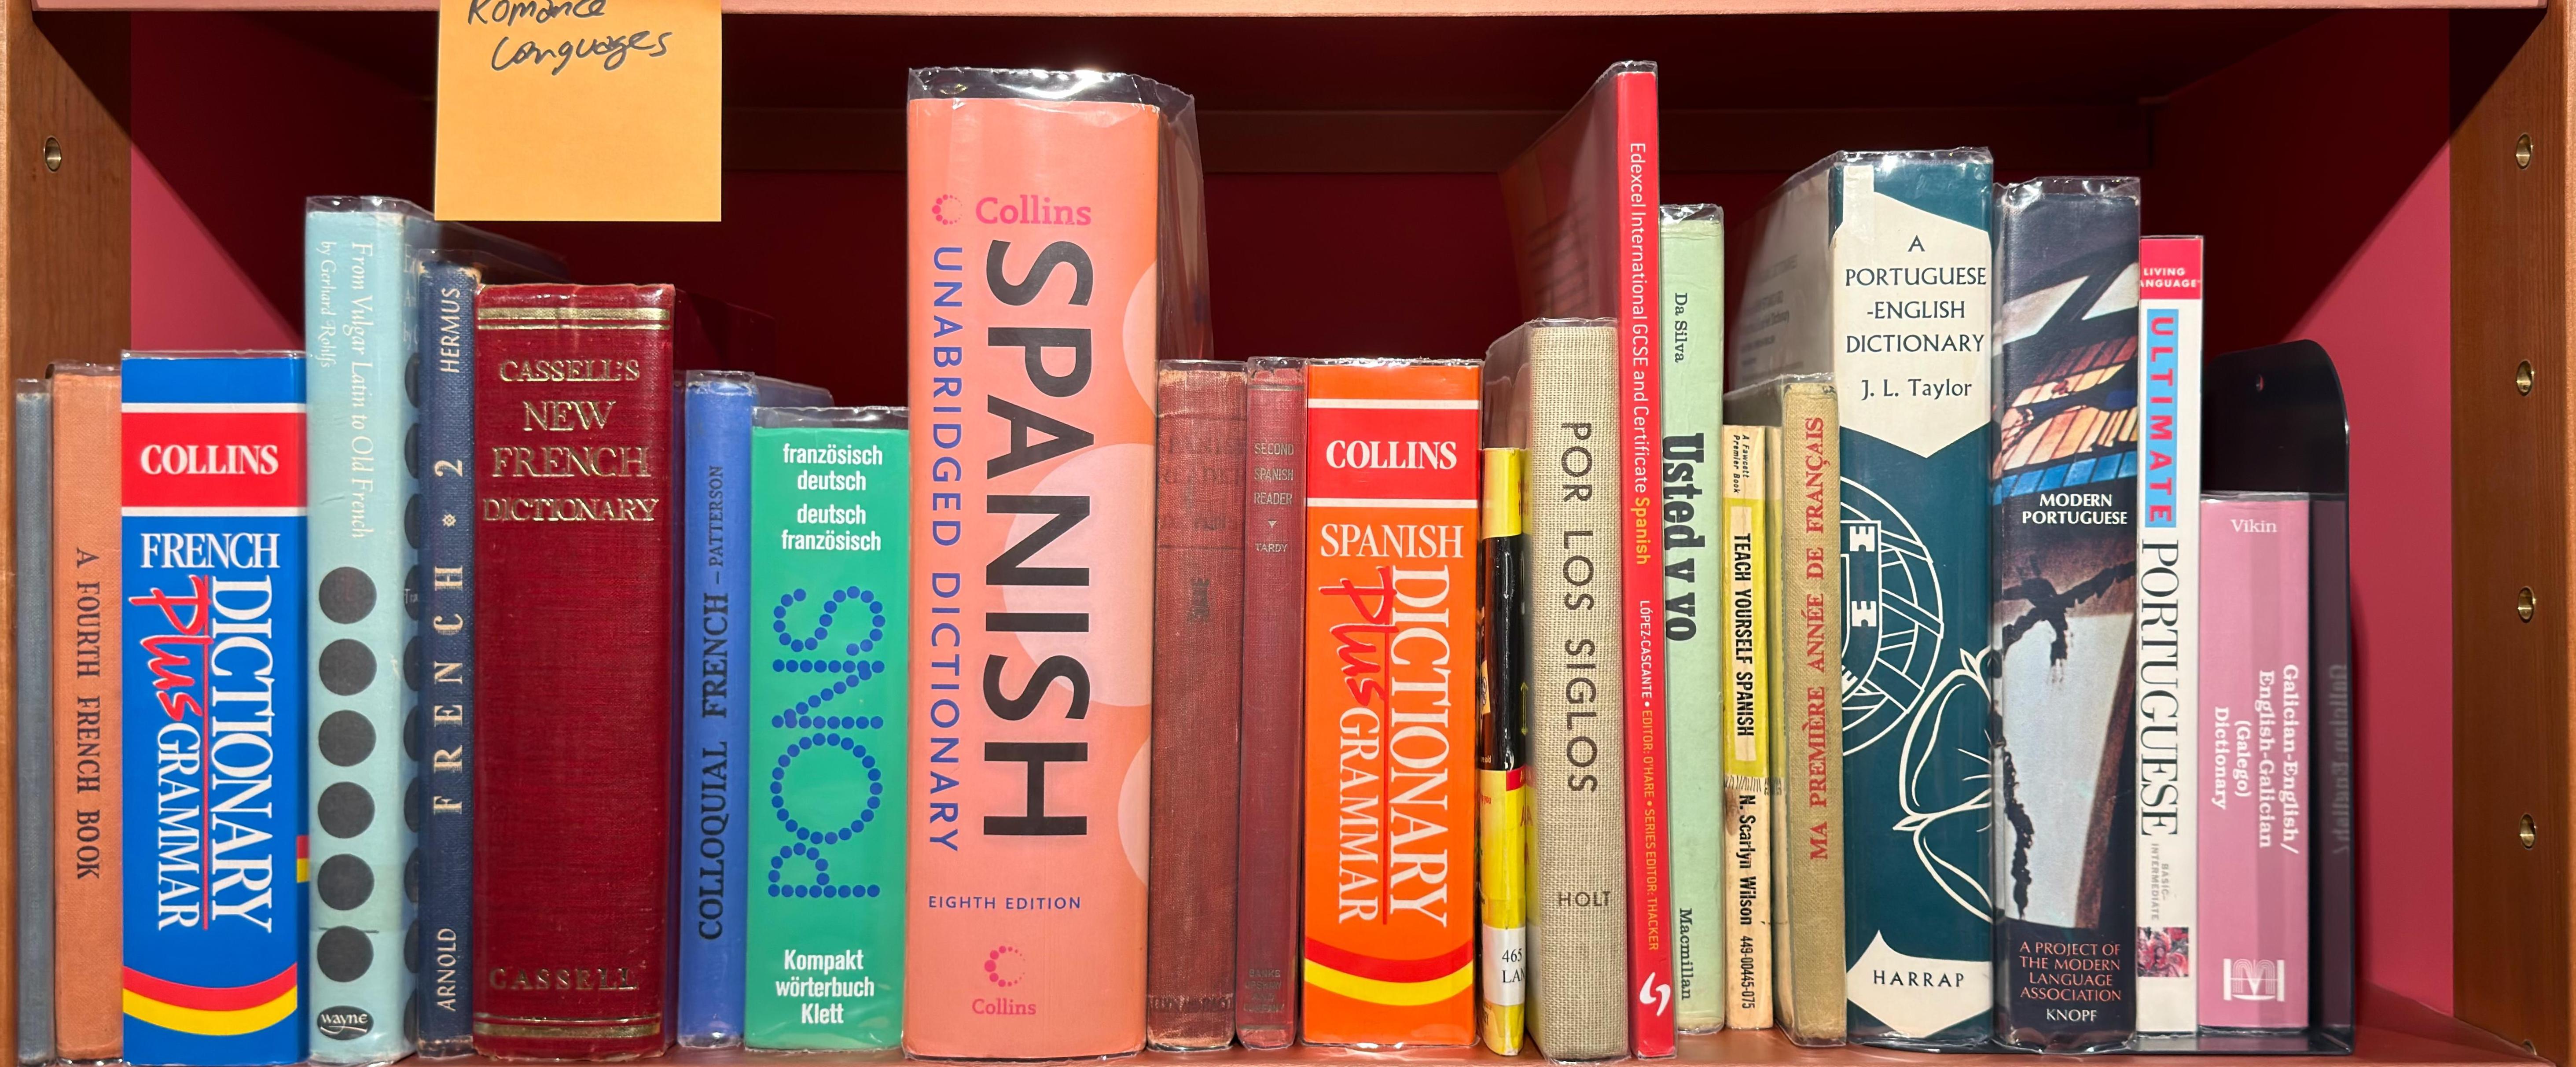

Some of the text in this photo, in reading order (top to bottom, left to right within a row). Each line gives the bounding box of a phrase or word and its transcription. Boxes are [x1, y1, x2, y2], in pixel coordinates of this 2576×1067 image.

[976, 195, 1091, 226] Collins
[1908, 235, 1925, 252] A
[1845, 267, 1986, 286] PORTUGUESE
[2140, 279, 2196, 287] ANGUAGE
[2143, 268, 2185, 276] LIVING
[316, 242, 337, 368] by Gerhard Rohlfs
[1867, 301, 1965, 319] -ENGLISH
[1675, 293, 1688, 363] Da Silva
[1630, 143, 1651, 564] Edexcel International GCSE and Certificate Spanish
[1847, 334, 1984, 353] DICTIONARY
[500, 359, 640, 382] CASSELL'S
[342, 243, 374, 538] From Vulgar Latin to Old French
[1861, 379, 1972, 401] J. L. Taylor
[523, 401, 616, 431] NEW
[2150, 316, 2174, 522] ULTIMATE
[140, 445, 278, 475] COLLINS
[492, 446, 651, 477] FRENCH
[783, 444, 883, 465] französisch
[1254, 443, 1294, 456] SECOND
[1326, 440, 1457, 470] COLLINS
[797, 470, 866, 491] deutsch
[1254, 467, 1293, 481] SPANISH
[1254, 492, 1292, 505] READER
[1663, 433, 1705, 550] Usted
[2039, 493, 2112, 507] MODERN
[483, 498, 659, 521] DICTIONARY
[709, 466, 724, 567] PATTERSON
[797, 504, 866, 525] deutsch
[2022, 511, 2128, 525] PORTUGUESE
[782, 530, 881, 551] französisch
[983, 239, 1094, 835] SPANISH
[1321, 523, 1464, 558] SPANISH
[2231, 519, 2277, 533] Vikin
[140, 534, 280, 568] FRENCH
[434, 287, 463, 815] FRENCH 2 HERMUS
[930, 247, 963, 851] UNABRIDGED DICTIONARY
[1256, 544, 1288, 552] TARDY
[1561, 423, 1598, 793] POR LOS SIGLOS
[1734, 534, 1754, 736] TEACH YOURSELF SPANISH
[1801, 418, 1830, 860] MA PREMIÈRE ANNÉE DE FRANÇAIS
[702, 593, 728, 718] FRENCH
[2140, 539, 2179, 835] PORTUGUESE
[76, 547, 100, 879] A FOURTH FRENCH BOOK
[129, 575, 213, 931] Plus GRAMMAR
[211, 576, 275, 933] DICTIONARY
[768, 586, 886, 897] PONS
[1319, 566, 1399, 925] Plus GRAMMAR
[1389, 565, 1452, 928] DICTIONARY
[2212, 707, 2230, 810] Dictionary
[2233, 720, 2252, 798] (Galego)
[2255, 670, 2276, 848] English-Galician
[1640, 600, 1658, 950] LÓPEZ-CASCANTE EDITOR: O'HARE SERIES EDITOR: THACKER
[1739, 795, 1756, 809] N.
[699, 742, 729, 940] COLLOQUIAL
[1736, 815, 1756, 869] Scarlyn
[929, 896, 1081, 909] EIGHTH EDITION
[1558, 891, 1611, 907] HOLT
[1739, 876, 1757, 925] Wilson
[784, 949, 864, 975] Kompakt
[1502, 948, 1522, 963] 465
[1679, 908, 1694, 1000] Macmillan
[2019, 941, 2120, 957] A PROJECT OF
[2019, 956, 2120, 971] THE MODERN
[437, 928, 456, 1011] ARNOLD
[490, 968, 639, 990] CASSELL
[1873, 970, 1964, 987] HARRAP
[2029, 973, 2113, 986] LANGUAGE
[776, 978, 875, 997] wörterbuch
[2020, 988, 2122, 1001] ASSOCIATION
[801, 1003, 844, 1024] Klett
[972, 998, 1036, 1015] Collins
[2046, 1009, 2097, 1022] KNOPF
[320, 1013, 368, 1033] wayne
